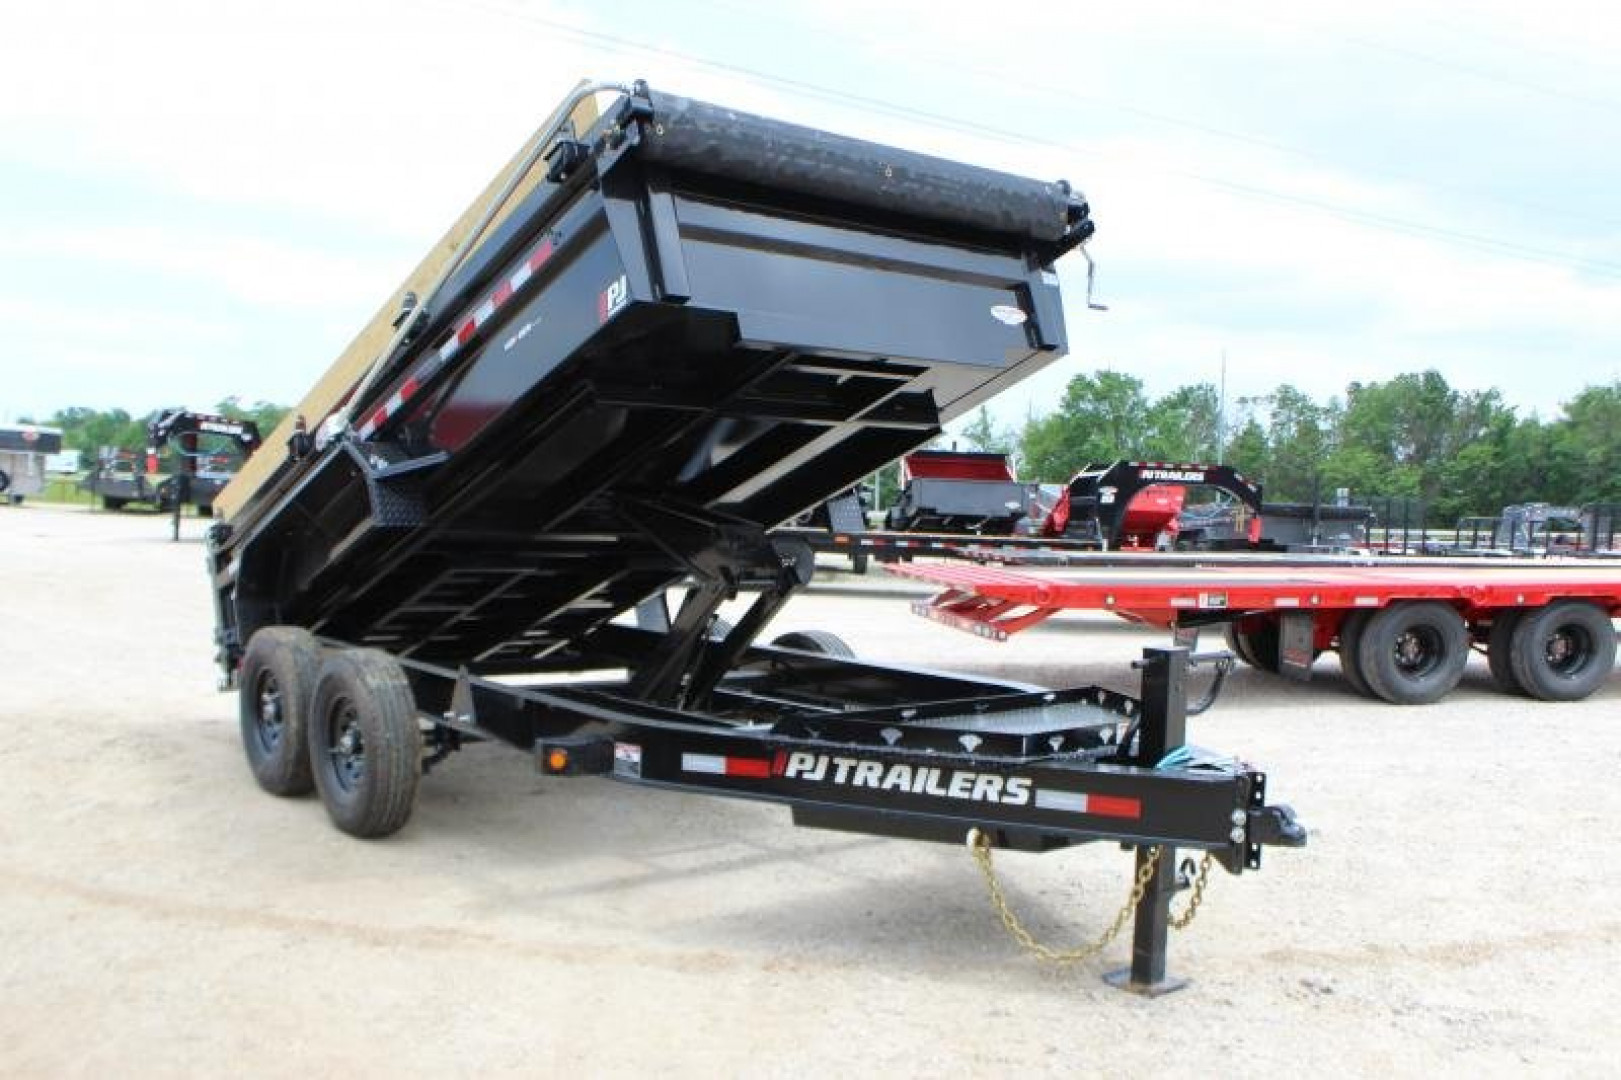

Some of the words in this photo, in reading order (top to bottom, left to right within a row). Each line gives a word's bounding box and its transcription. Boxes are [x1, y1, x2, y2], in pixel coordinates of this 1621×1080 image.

[607, 275, 627, 308] PJ
[786, 752, 829, 780] PJ
[833, 757, 1032, 806] TRAILERS
